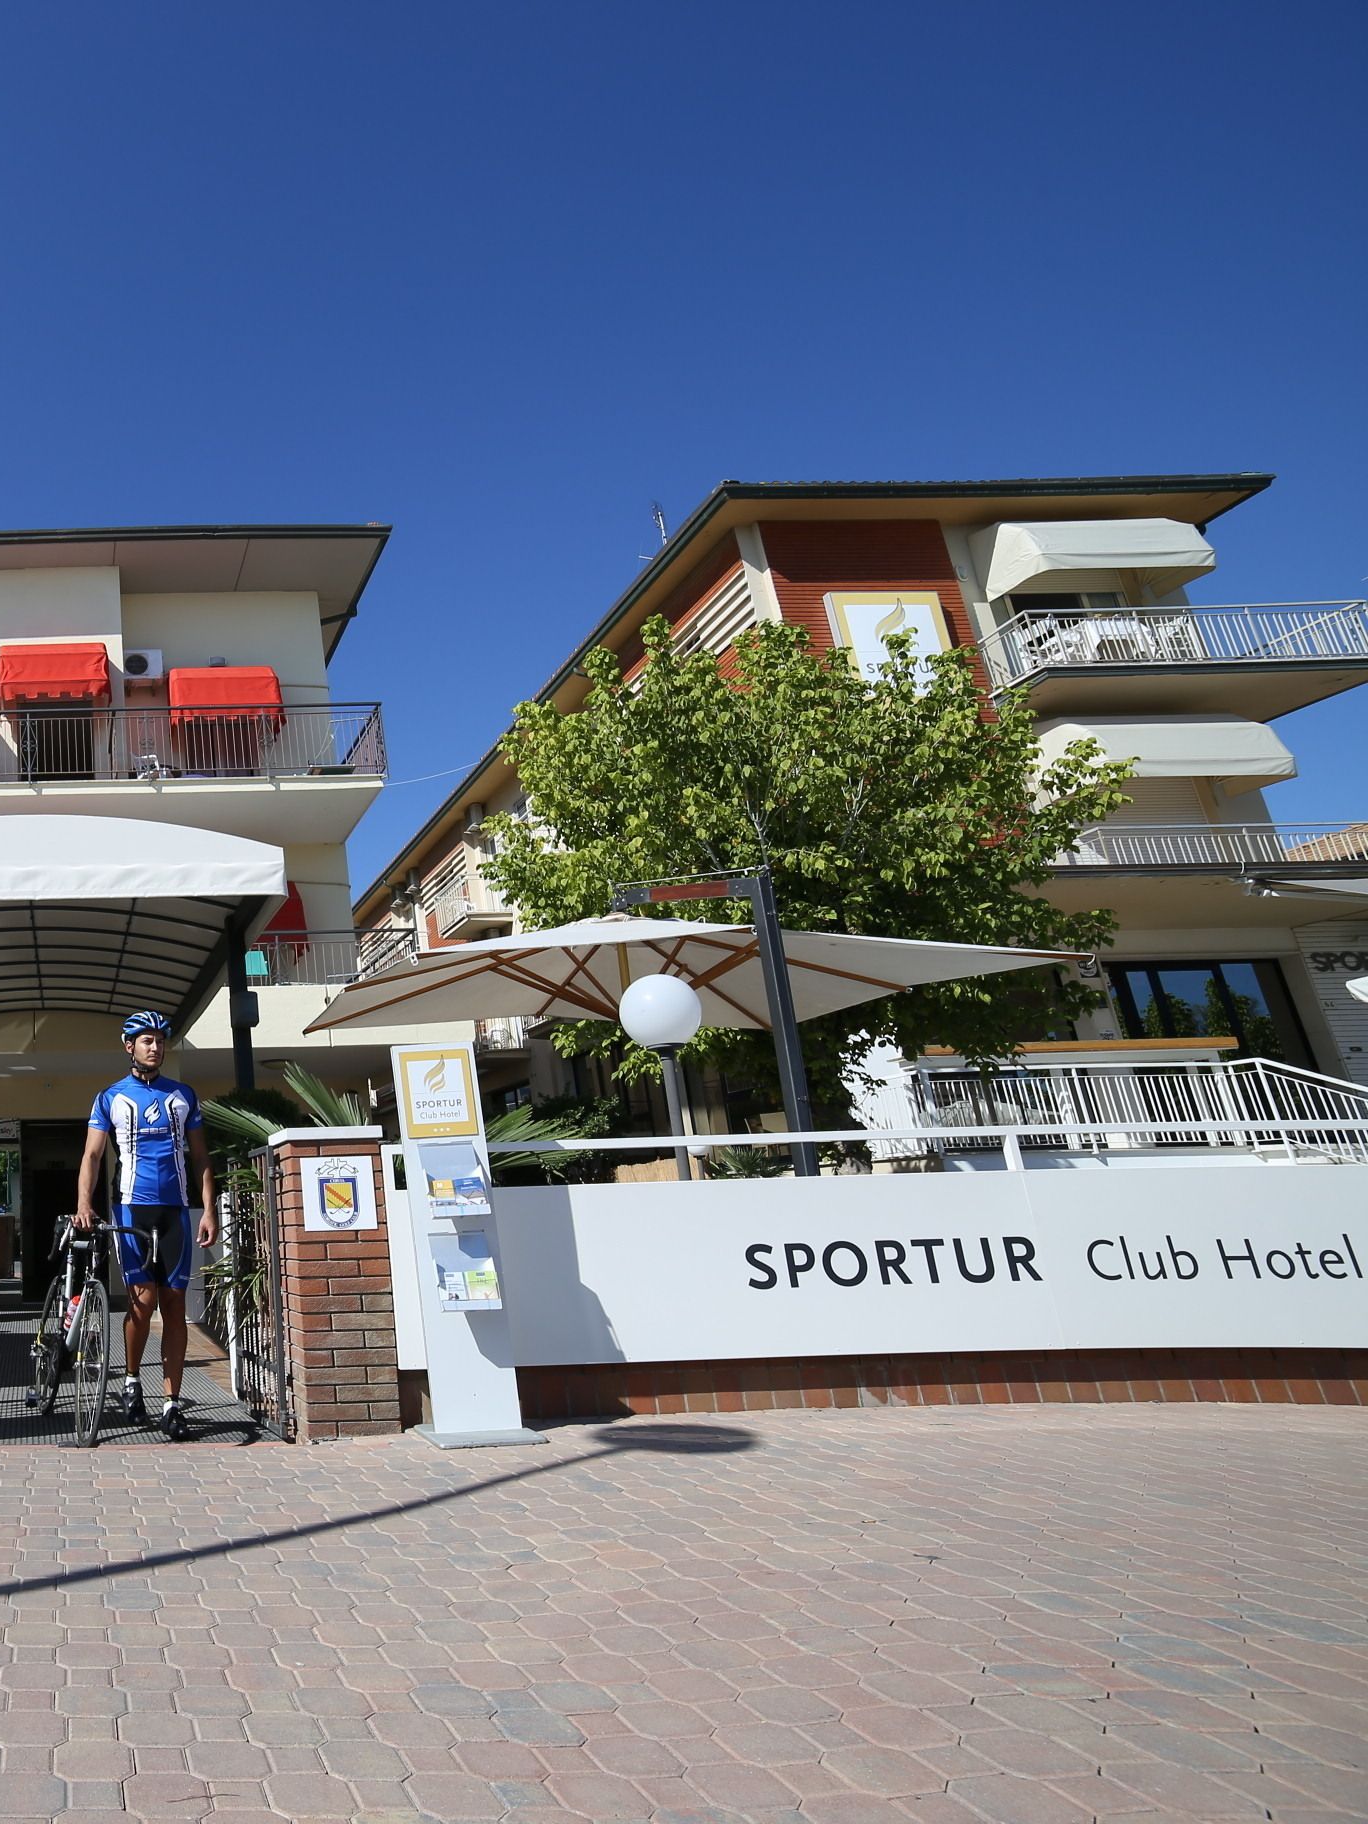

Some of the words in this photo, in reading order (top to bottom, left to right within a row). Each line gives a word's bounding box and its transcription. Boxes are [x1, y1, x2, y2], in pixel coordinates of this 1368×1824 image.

[415, 1098, 463, 1109] SPORTUR
[419, 1112, 438, 1120] Club
[439, 1110, 461, 1119] Hotel
[745, 1236, 1043, 1290] SPORTUR
[1085, 1234, 1199, 1282] Club
[1215, 1233, 1364, 1281] Hotel
